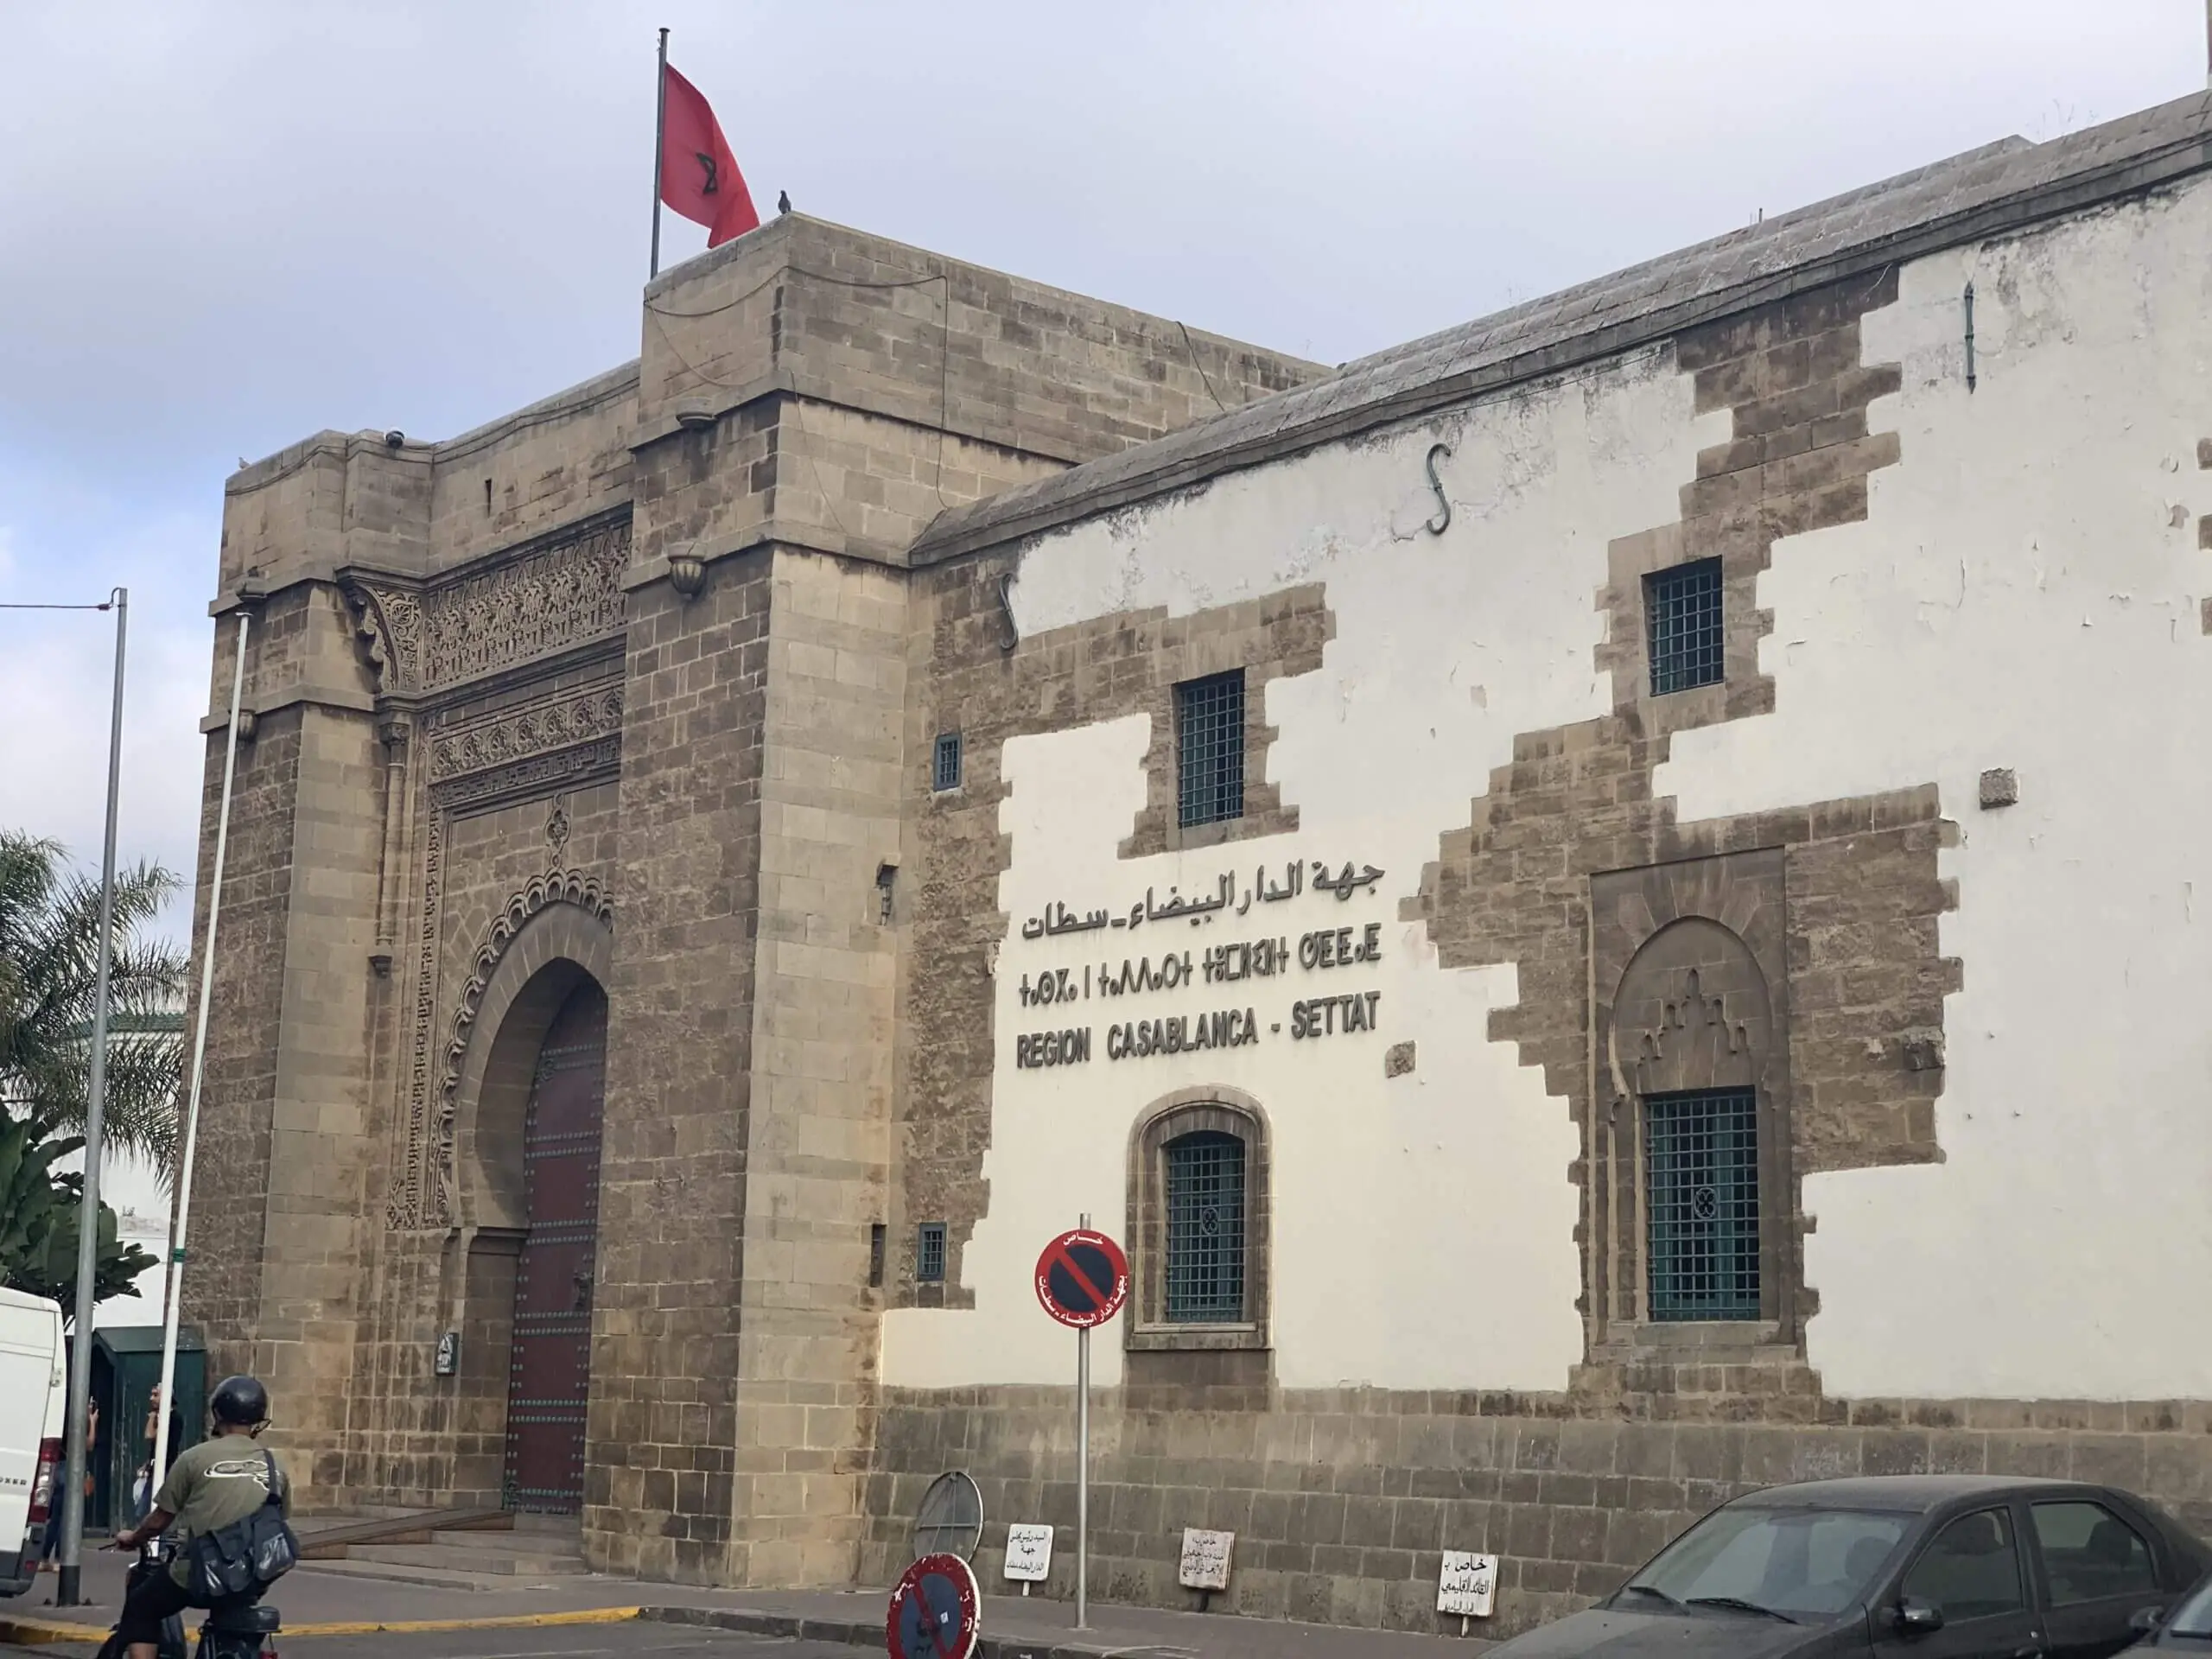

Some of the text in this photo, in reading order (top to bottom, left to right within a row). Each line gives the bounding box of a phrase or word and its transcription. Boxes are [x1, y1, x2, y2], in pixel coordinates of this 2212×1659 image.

[1236, 858, 1304, 916] الدار
[1312, 861, 1385, 901] جهة
[1017, 1026, 1091, 1069] REGION
[1107, 1007, 1259, 1060] CASABLANCA
[1291, 990, 1382, 1039] SETTAT
[1063, 1231, 1103, 1246] خاص
[1455, 1554, 1487, 1573] خاص
